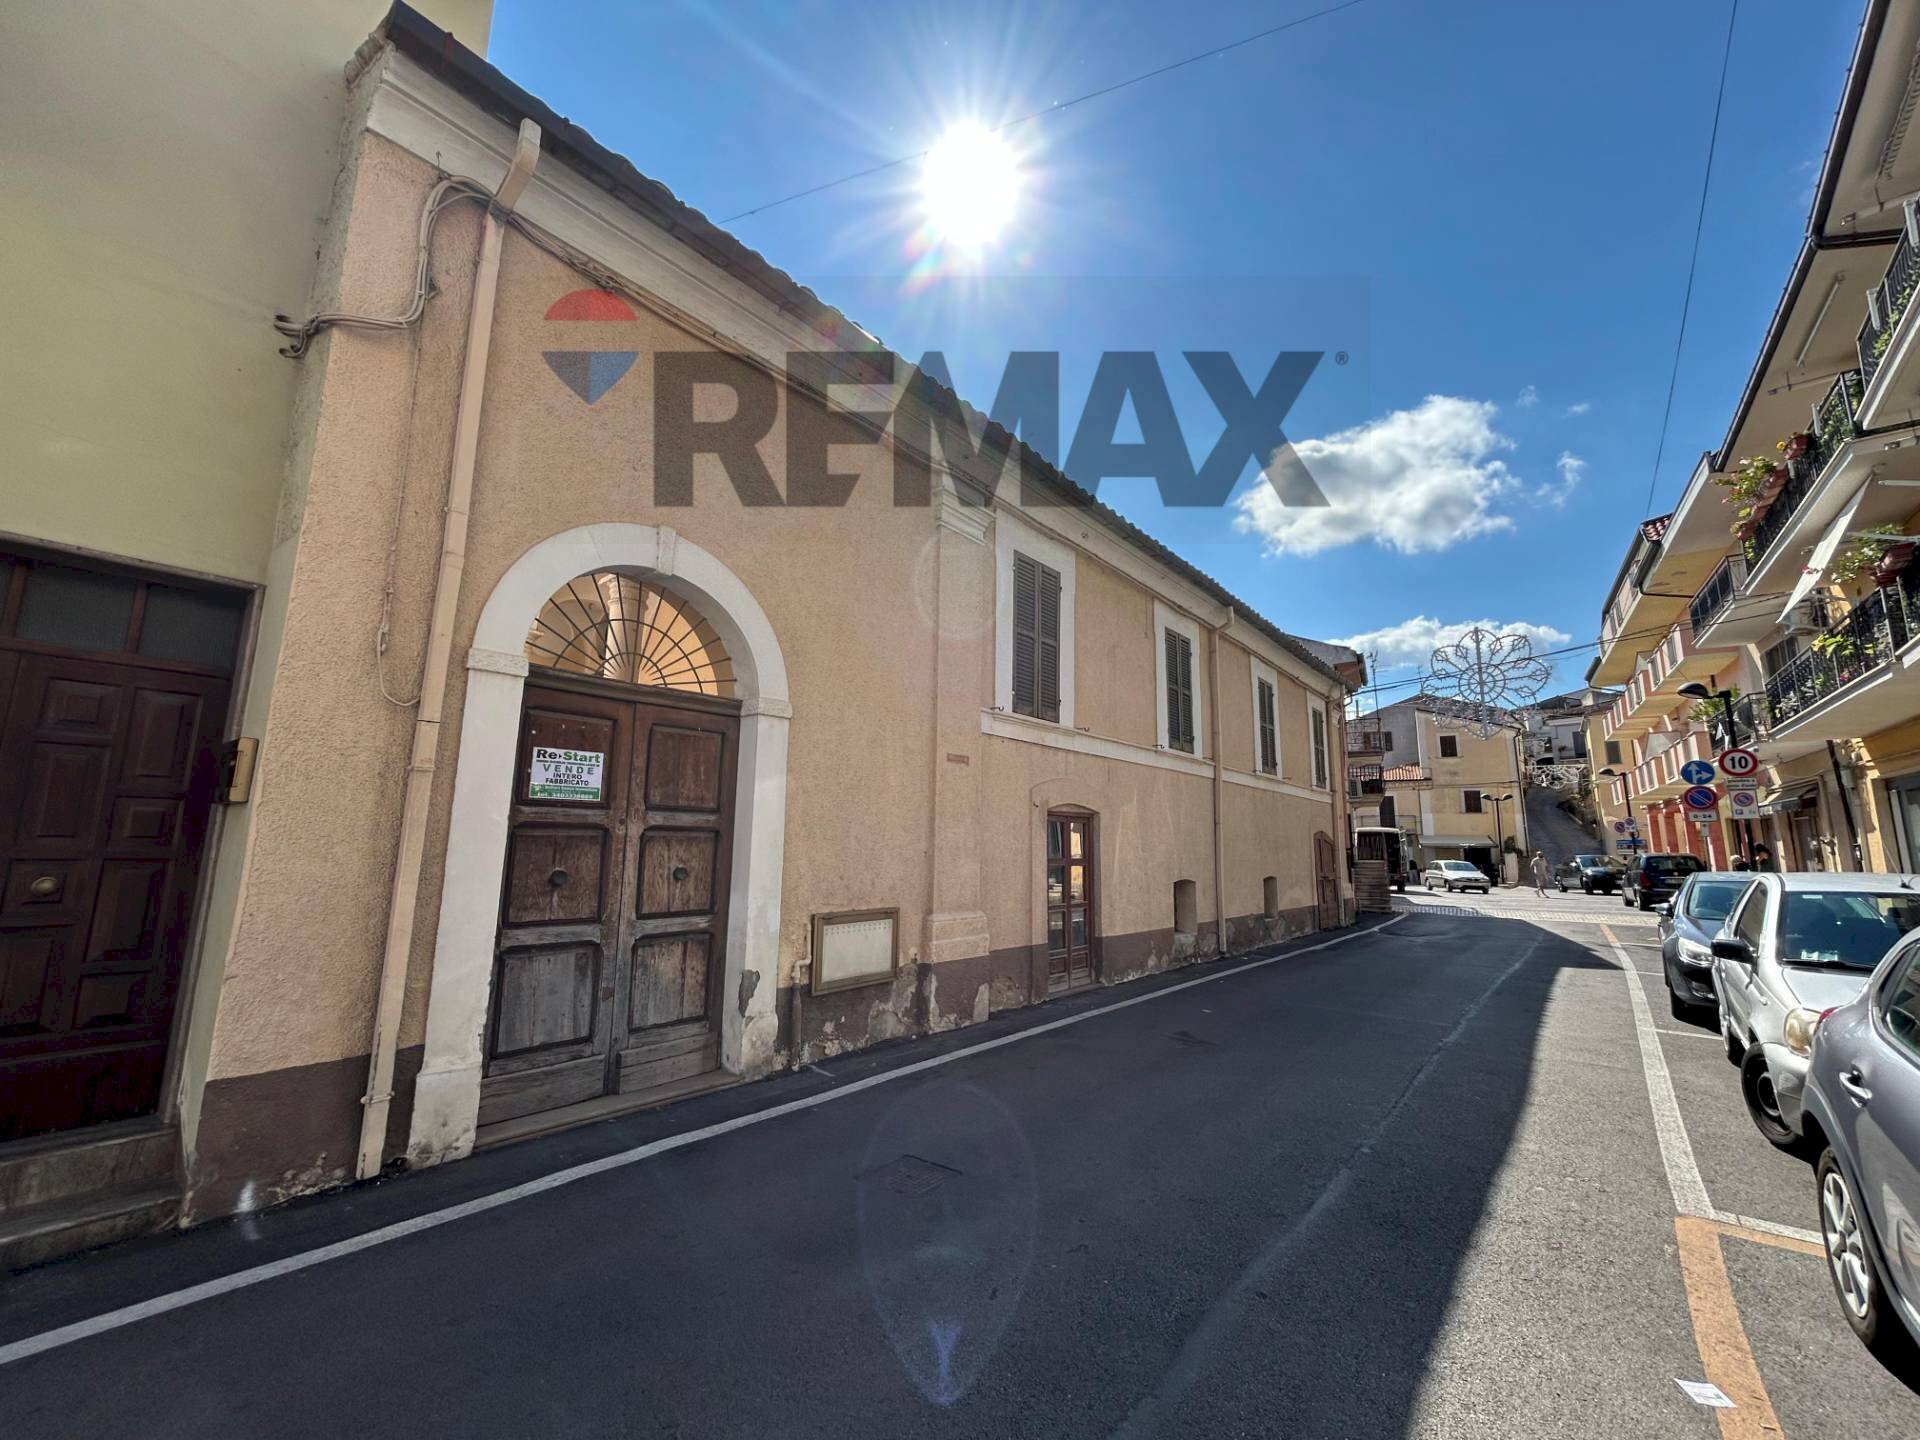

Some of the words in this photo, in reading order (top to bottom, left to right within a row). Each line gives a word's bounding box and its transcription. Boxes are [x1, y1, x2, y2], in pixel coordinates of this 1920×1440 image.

[1729, 756, 1749, 770] 10
[543, 764, 594, 775] VENDE
[545, 778, 589, 786] FABBRICATO
